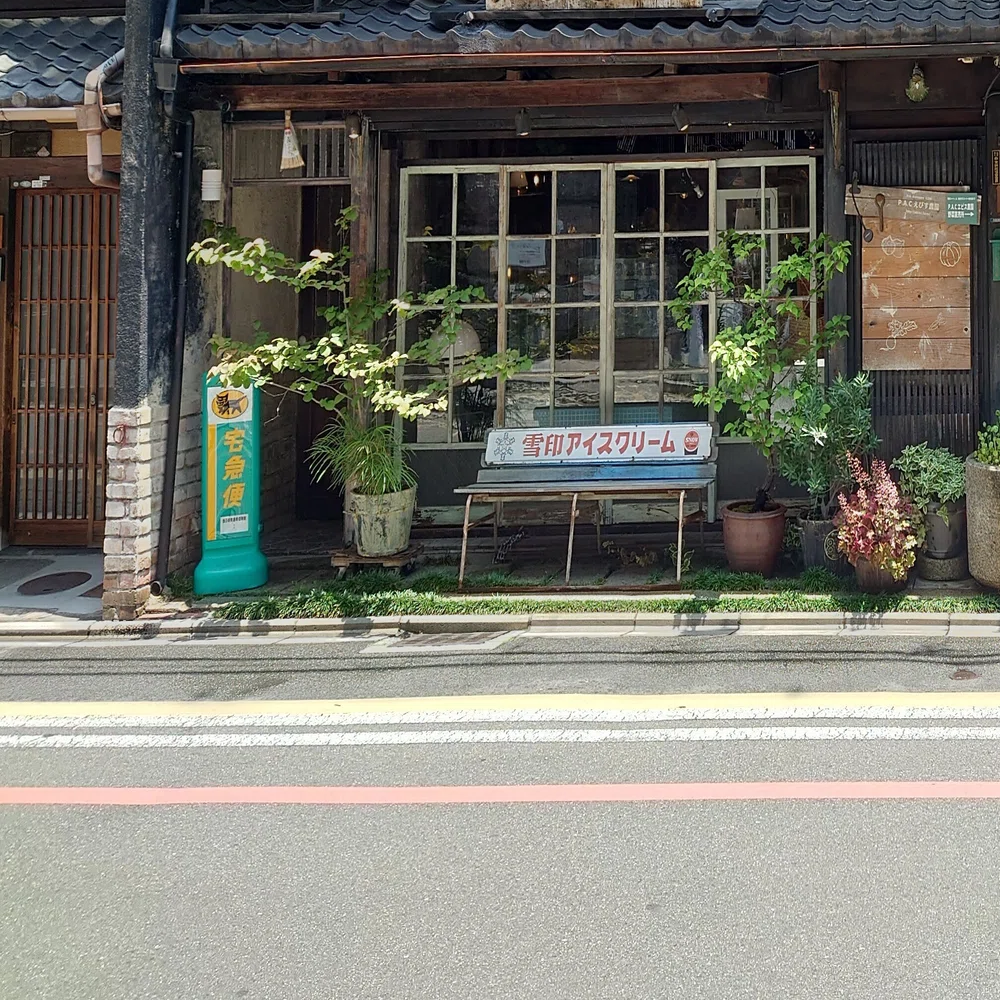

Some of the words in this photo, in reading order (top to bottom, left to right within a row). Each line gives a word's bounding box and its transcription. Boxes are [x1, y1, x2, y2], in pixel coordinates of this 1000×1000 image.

[222, 427, 246, 509] 宅急便
[522, 430, 676, 458] 雪印アイスクリーム
